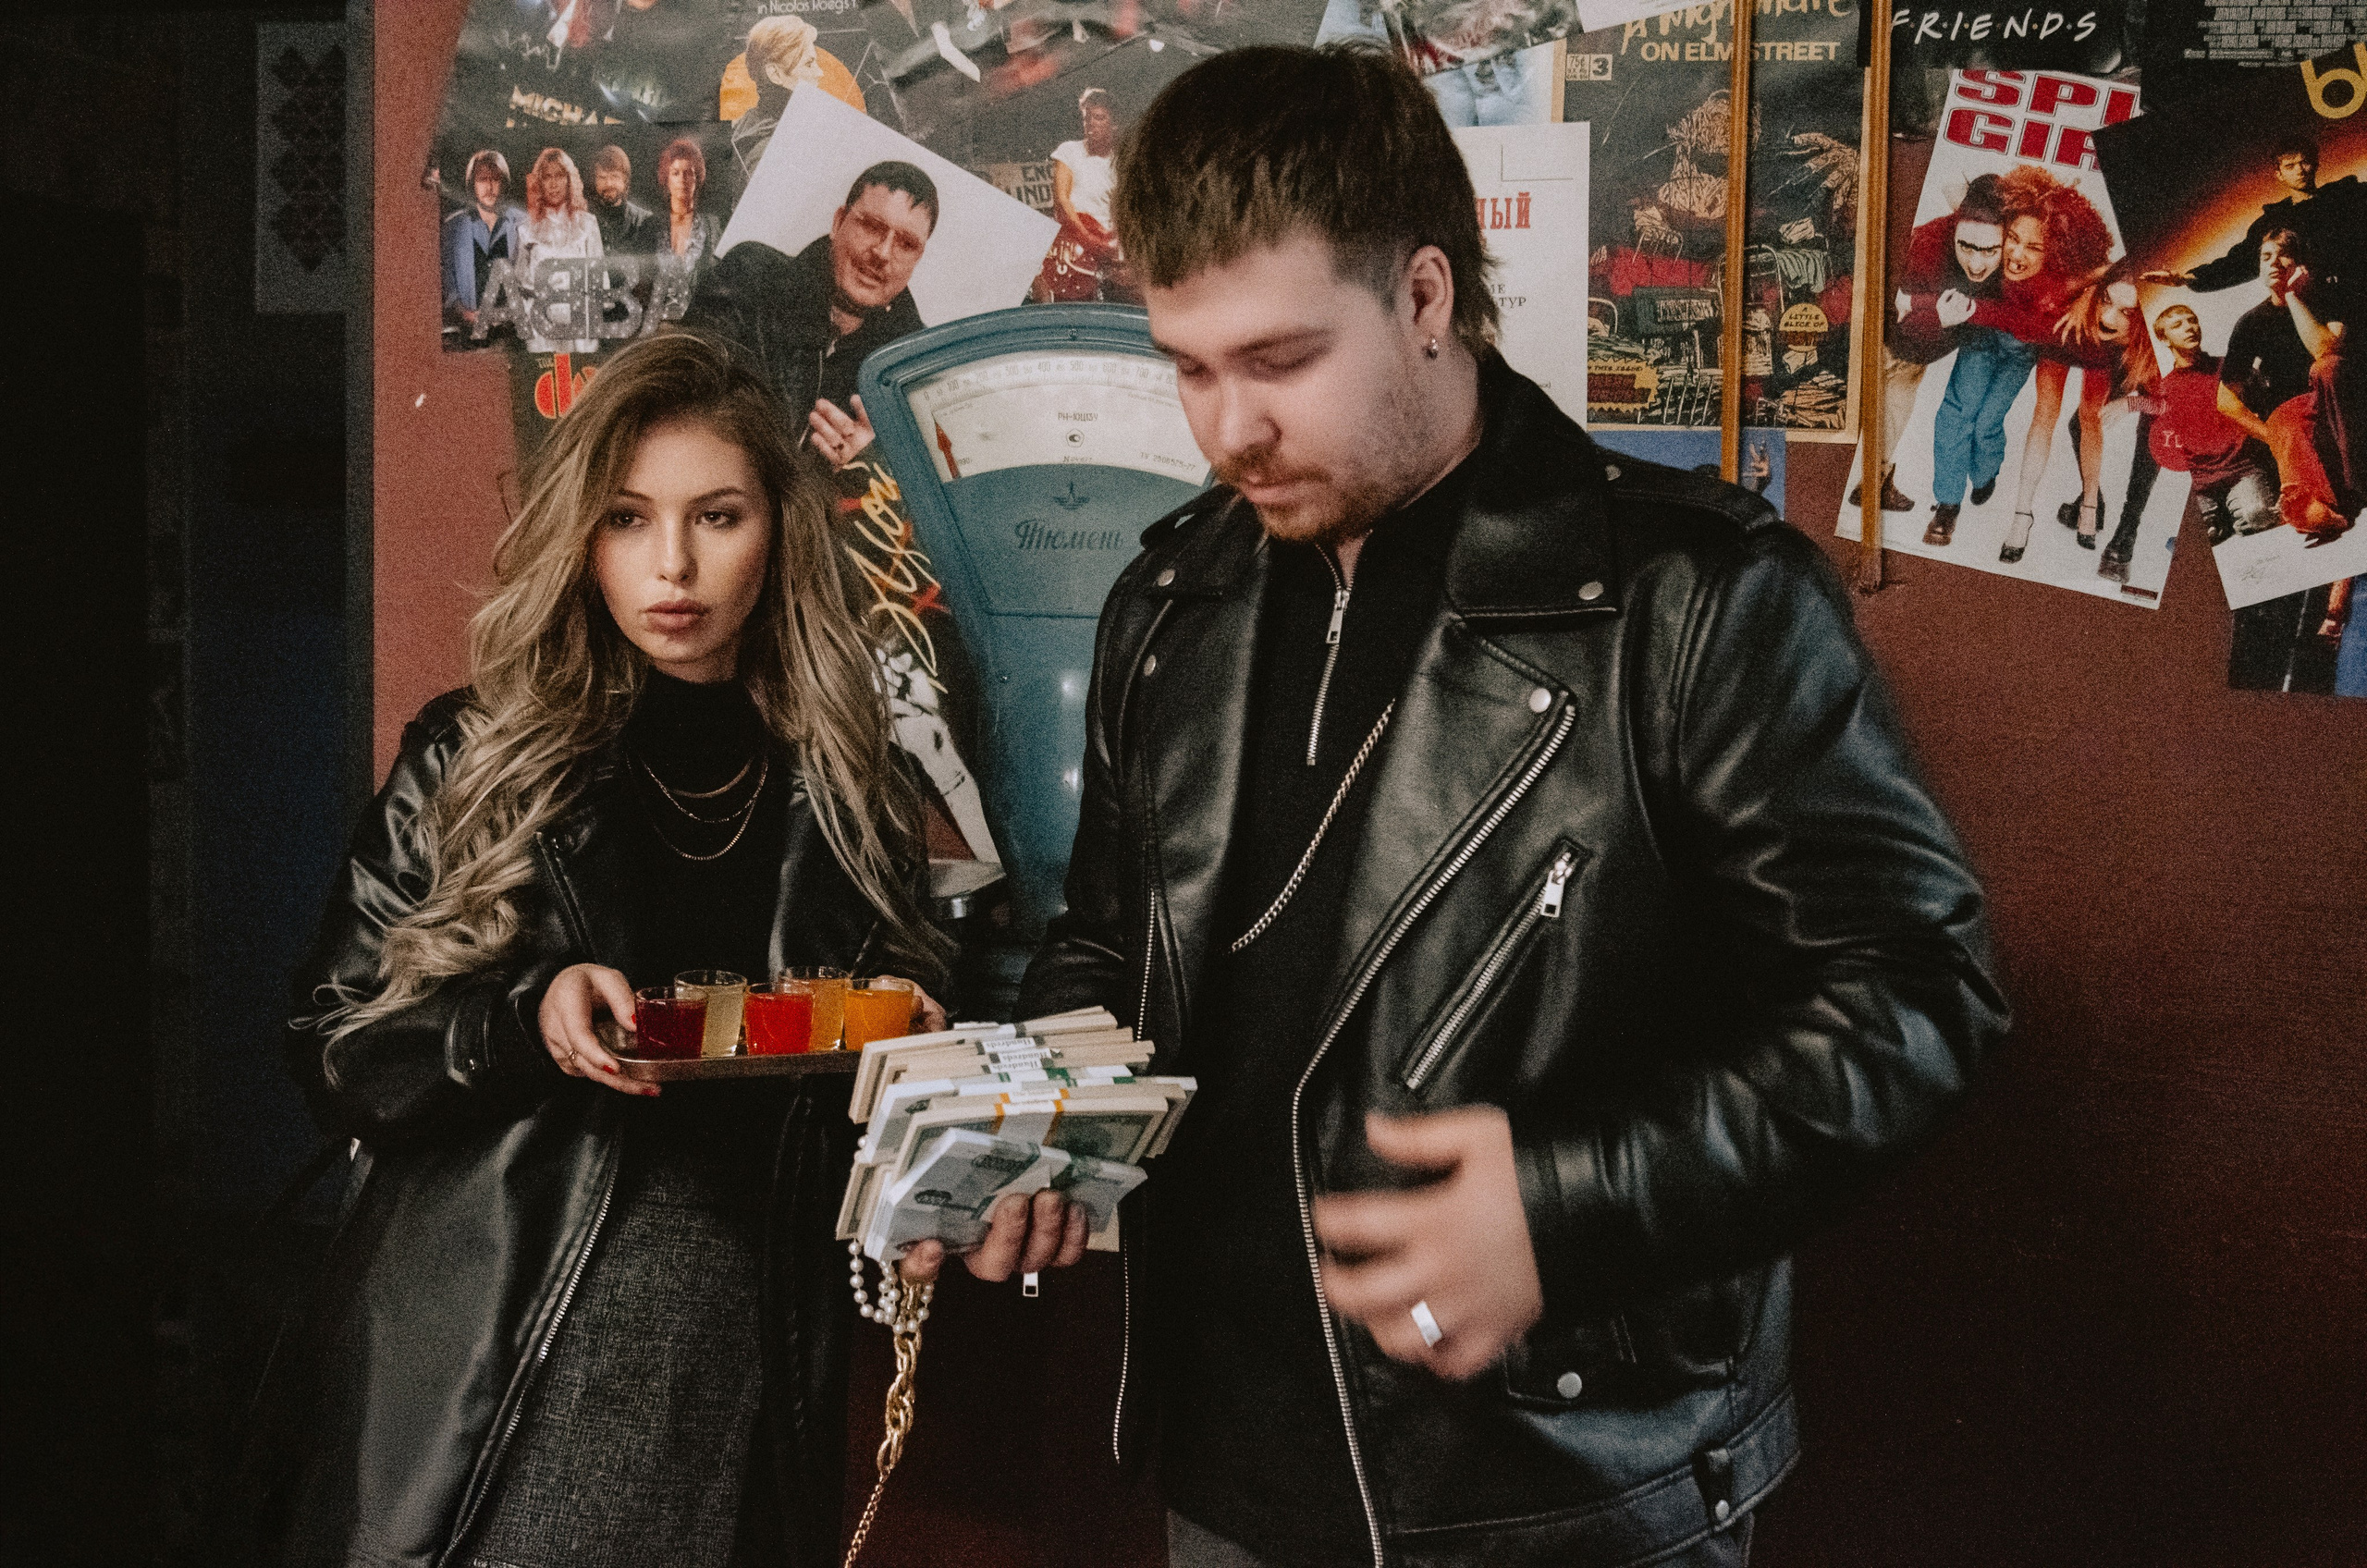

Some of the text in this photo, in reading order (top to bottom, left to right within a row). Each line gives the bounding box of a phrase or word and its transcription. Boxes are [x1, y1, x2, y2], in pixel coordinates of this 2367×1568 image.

[1641, 42, 1680, 62] ON
[1685, 42, 1734, 62] ELM
[1592, 57, 1609, 77] 3
